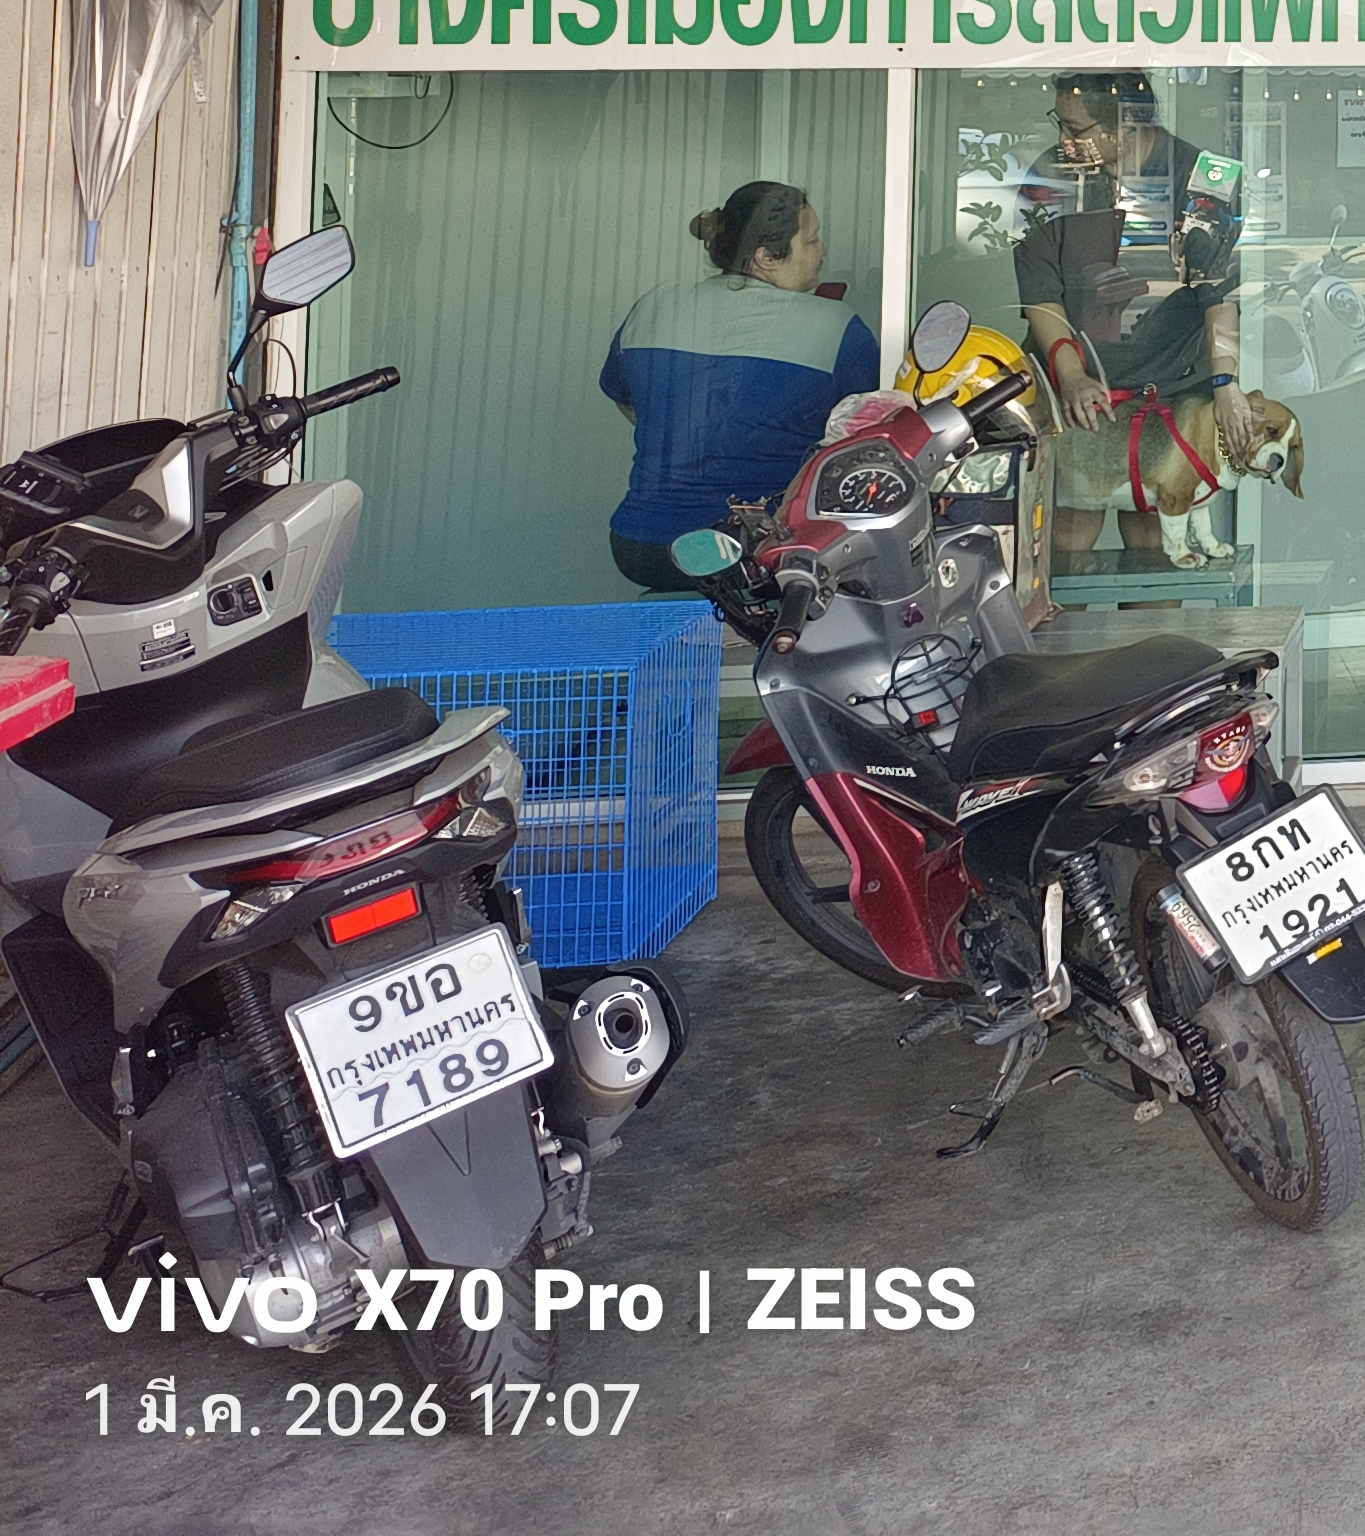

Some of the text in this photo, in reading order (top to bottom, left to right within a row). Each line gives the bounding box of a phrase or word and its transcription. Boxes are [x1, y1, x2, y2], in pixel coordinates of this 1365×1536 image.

[865, 765, 917, 778] HONDA
[343, 869, 406, 896] HONDA
[1221, 840, 1355, 927] กรุงเทพมหานคร
[1226, 818, 1312, 882] 8กท
[1171, 900, 1203, 934] 2569
[1260, 877, 1359, 953] 1921
[348, 963, 462, 1032] 9ขอ
[326, 993, 516, 1089] กรุงเทพมหานคร
[357, 1038, 510, 1128] 7189
